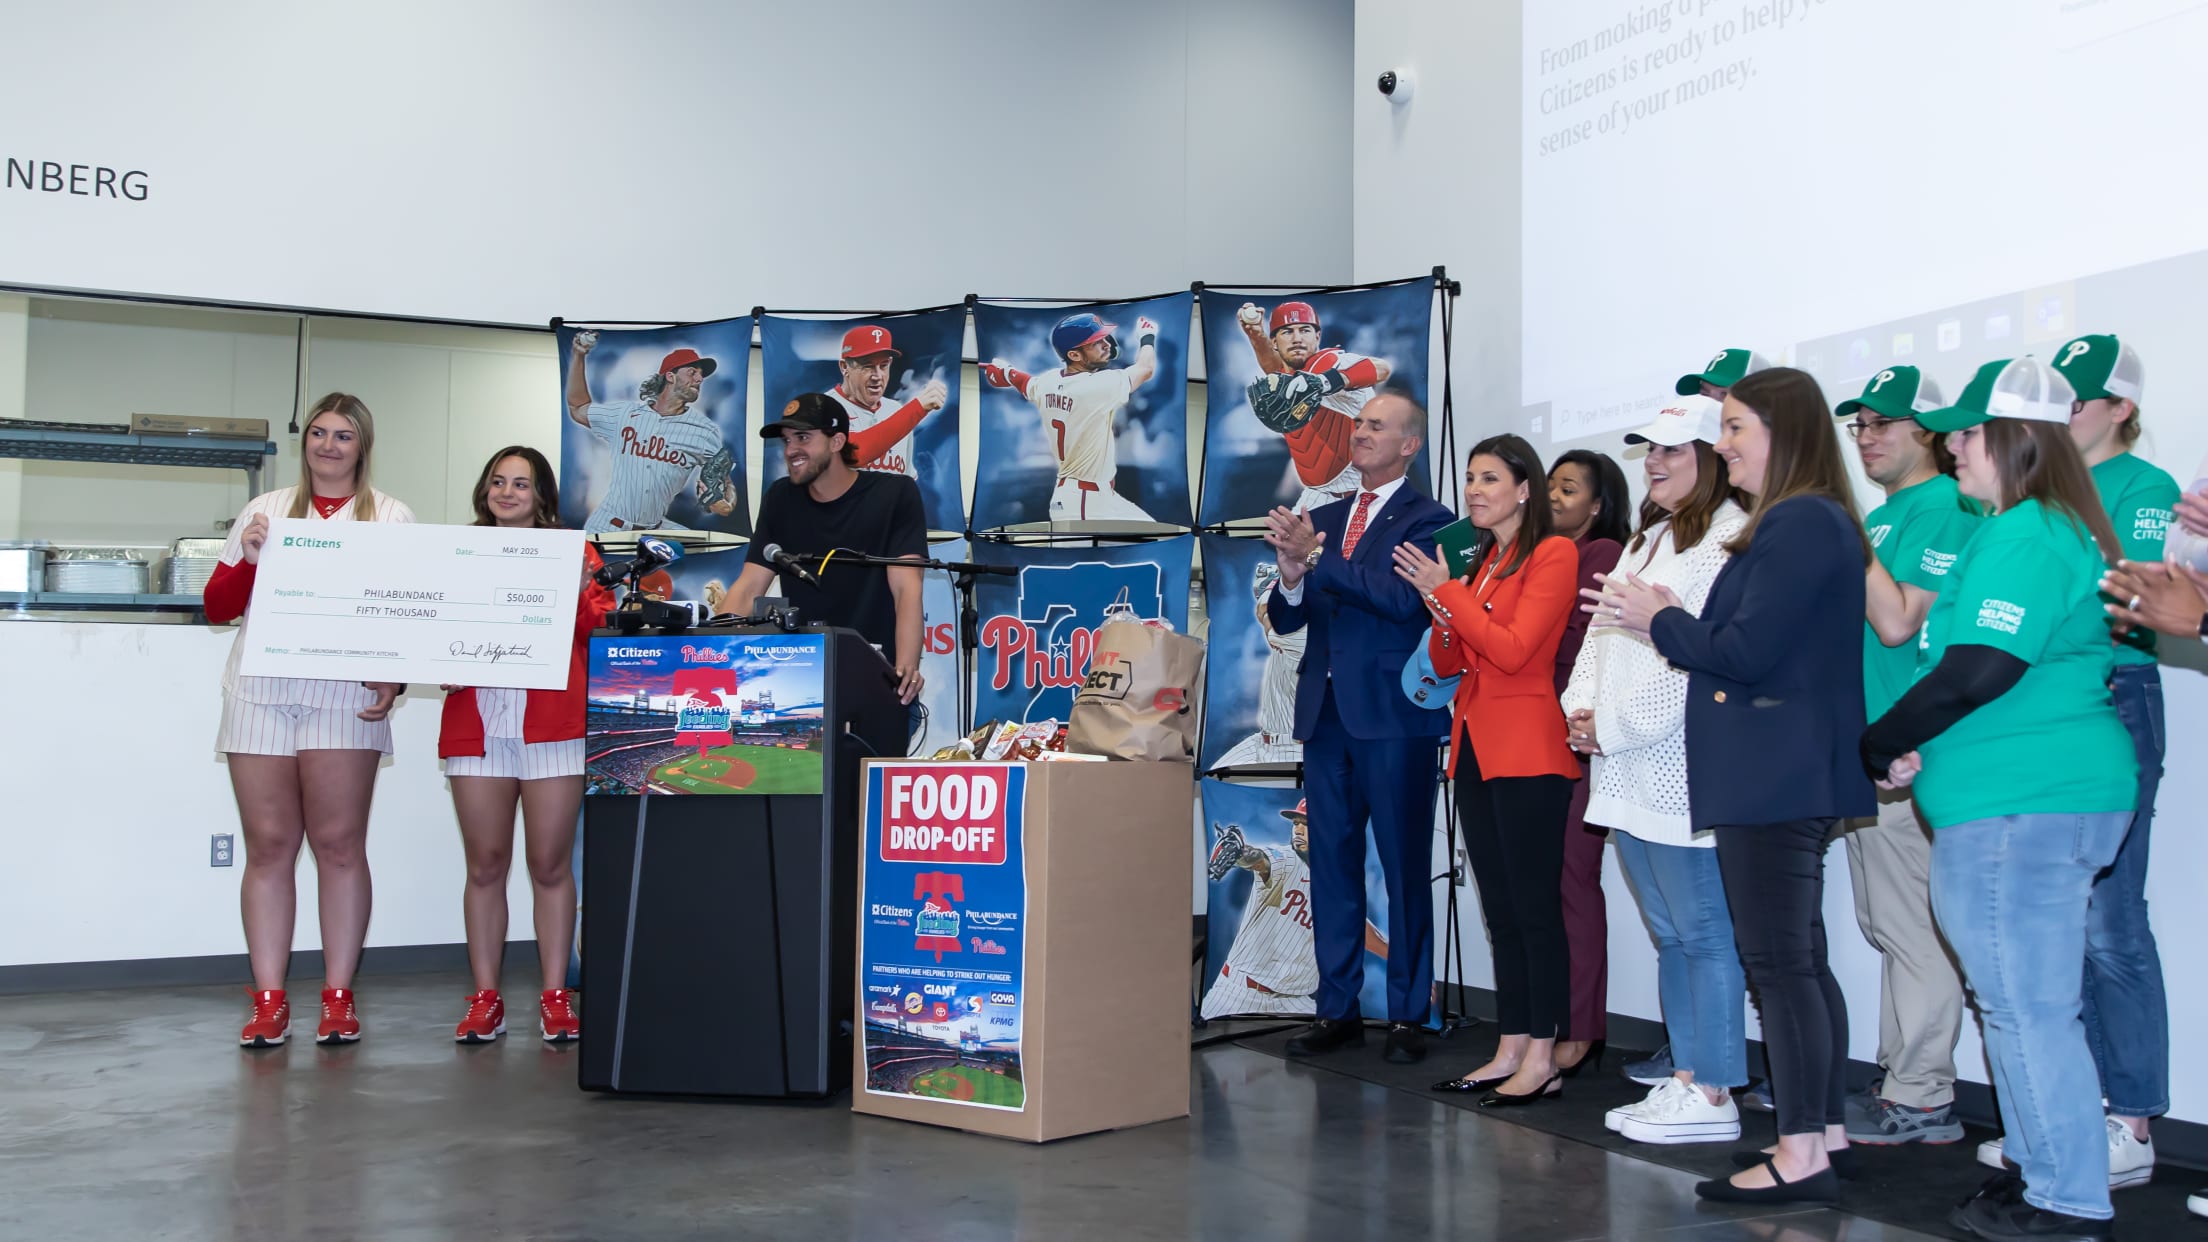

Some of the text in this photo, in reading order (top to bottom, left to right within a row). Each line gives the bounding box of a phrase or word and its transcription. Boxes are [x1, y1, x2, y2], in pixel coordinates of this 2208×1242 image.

[1540, 39, 1588, 76] From
[1594, 0, 1673, 53] making
[1540, 67, 1617, 116] Citizens
[1623, 55, 1638, 83] is
[1644, 28, 1708, 75] ready
[1713, 20, 1735, 46] to
[1742, 0, 1794, 35] help
[1539, 56, 1757, 157] sense of your money.
[7, 158, 148, 201] NBERG
[1045, 393, 1073, 412] TURNER
[1577, 409, 1597, 424] Type
[1600, 405, 1620, 418] here
[621, 426, 688, 466] Phillies
[1051, 418, 1066, 461] 7
[2134, 518, 2169, 529] HELPI
[295, 537, 341, 549] Citizens
[2132, 529, 2165, 541] CITIZ
[502, 546, 518, 554] MAY
[274, 588, 305, 600] Payable
[364, 589, 445, 601] PHILABUNDANCE
[506, 592, 545, 604] $50,000
[356, 606, 552, 624] FIFTY THOUSAND Dollars
[618, 646, 661, 658] Citizens
[681, 645, 729, 663] Phillies
[891, 774, 998, 821] FOOD
[890, 825, 996, 852] DROP-OFF
[880, 904, 913, 917] Citizens
[898, 967, 910, 975] WHO
[911, 968, 921, 976] ARE
[922, 969, 945, 978] HELPING
[946, 970, 954, 978] TO
[954, 971, 973, 980] STRIKE
[924, 984, 957, 996] GIANT
[991, 993, 1015, 1004] GOYA
[990, 1016, 1015, 1027] KPMG
